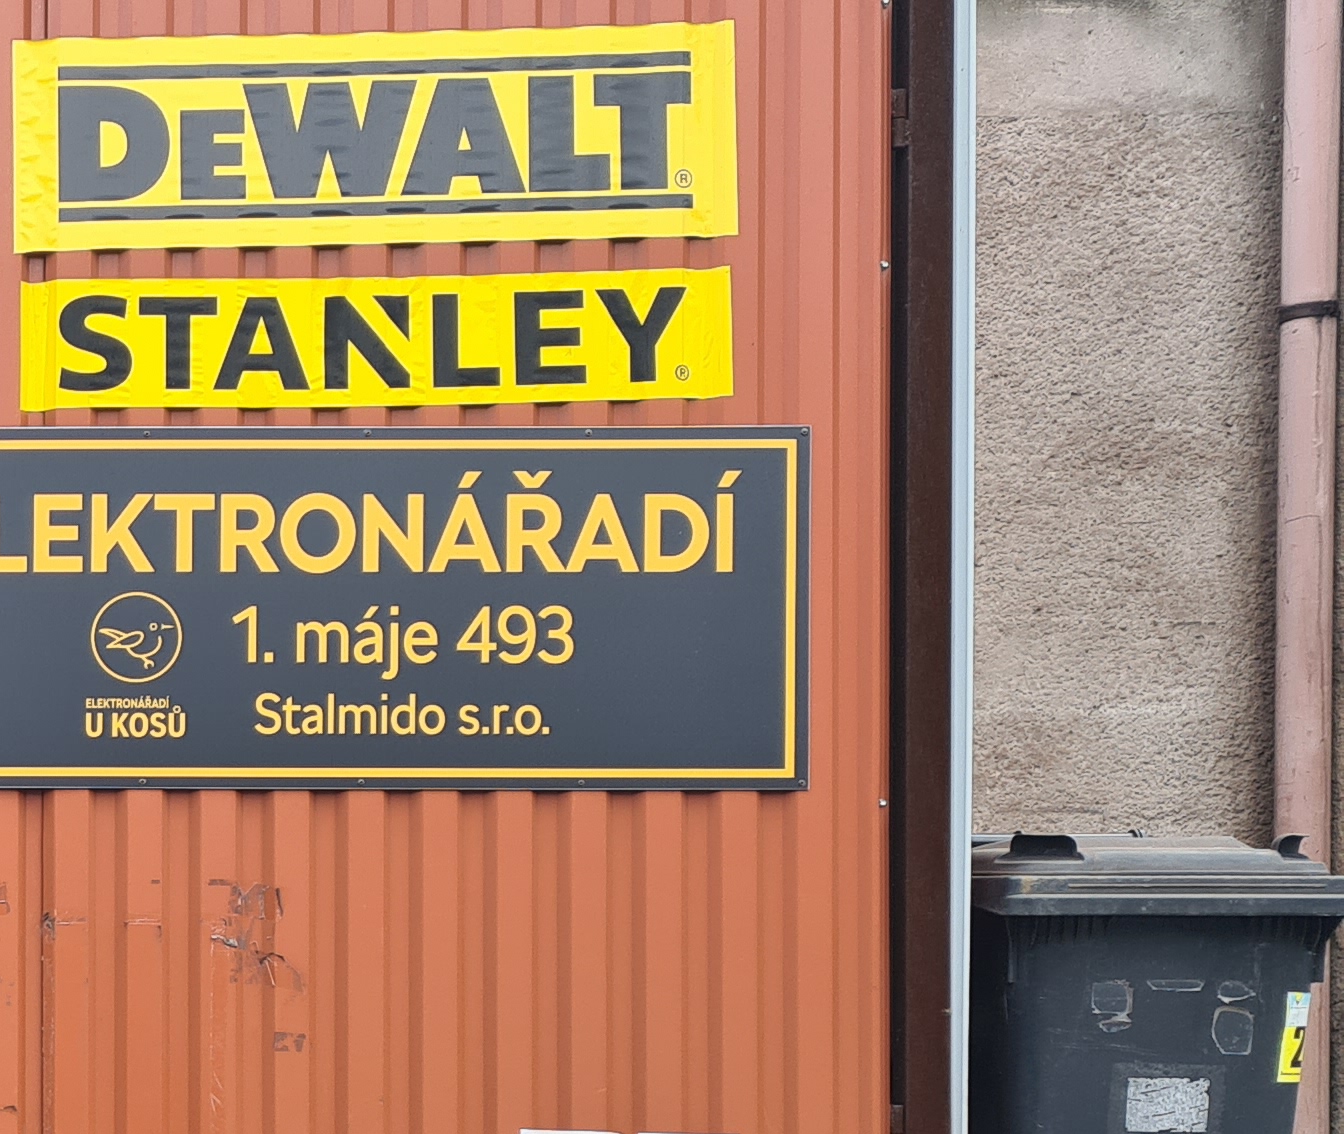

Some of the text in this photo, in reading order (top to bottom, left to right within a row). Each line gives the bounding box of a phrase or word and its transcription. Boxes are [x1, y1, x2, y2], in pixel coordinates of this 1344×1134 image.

[58, 287, 687, 392] STANLEY
[232, 604, 575, 680] 1. máje 493
[85, 695, 170, 709] ELEKTRONÁŘADÍ
[85, 705, 186, 738] U KOSŮ
[254, 693, 551, 738] Stalmido s.r.o.
